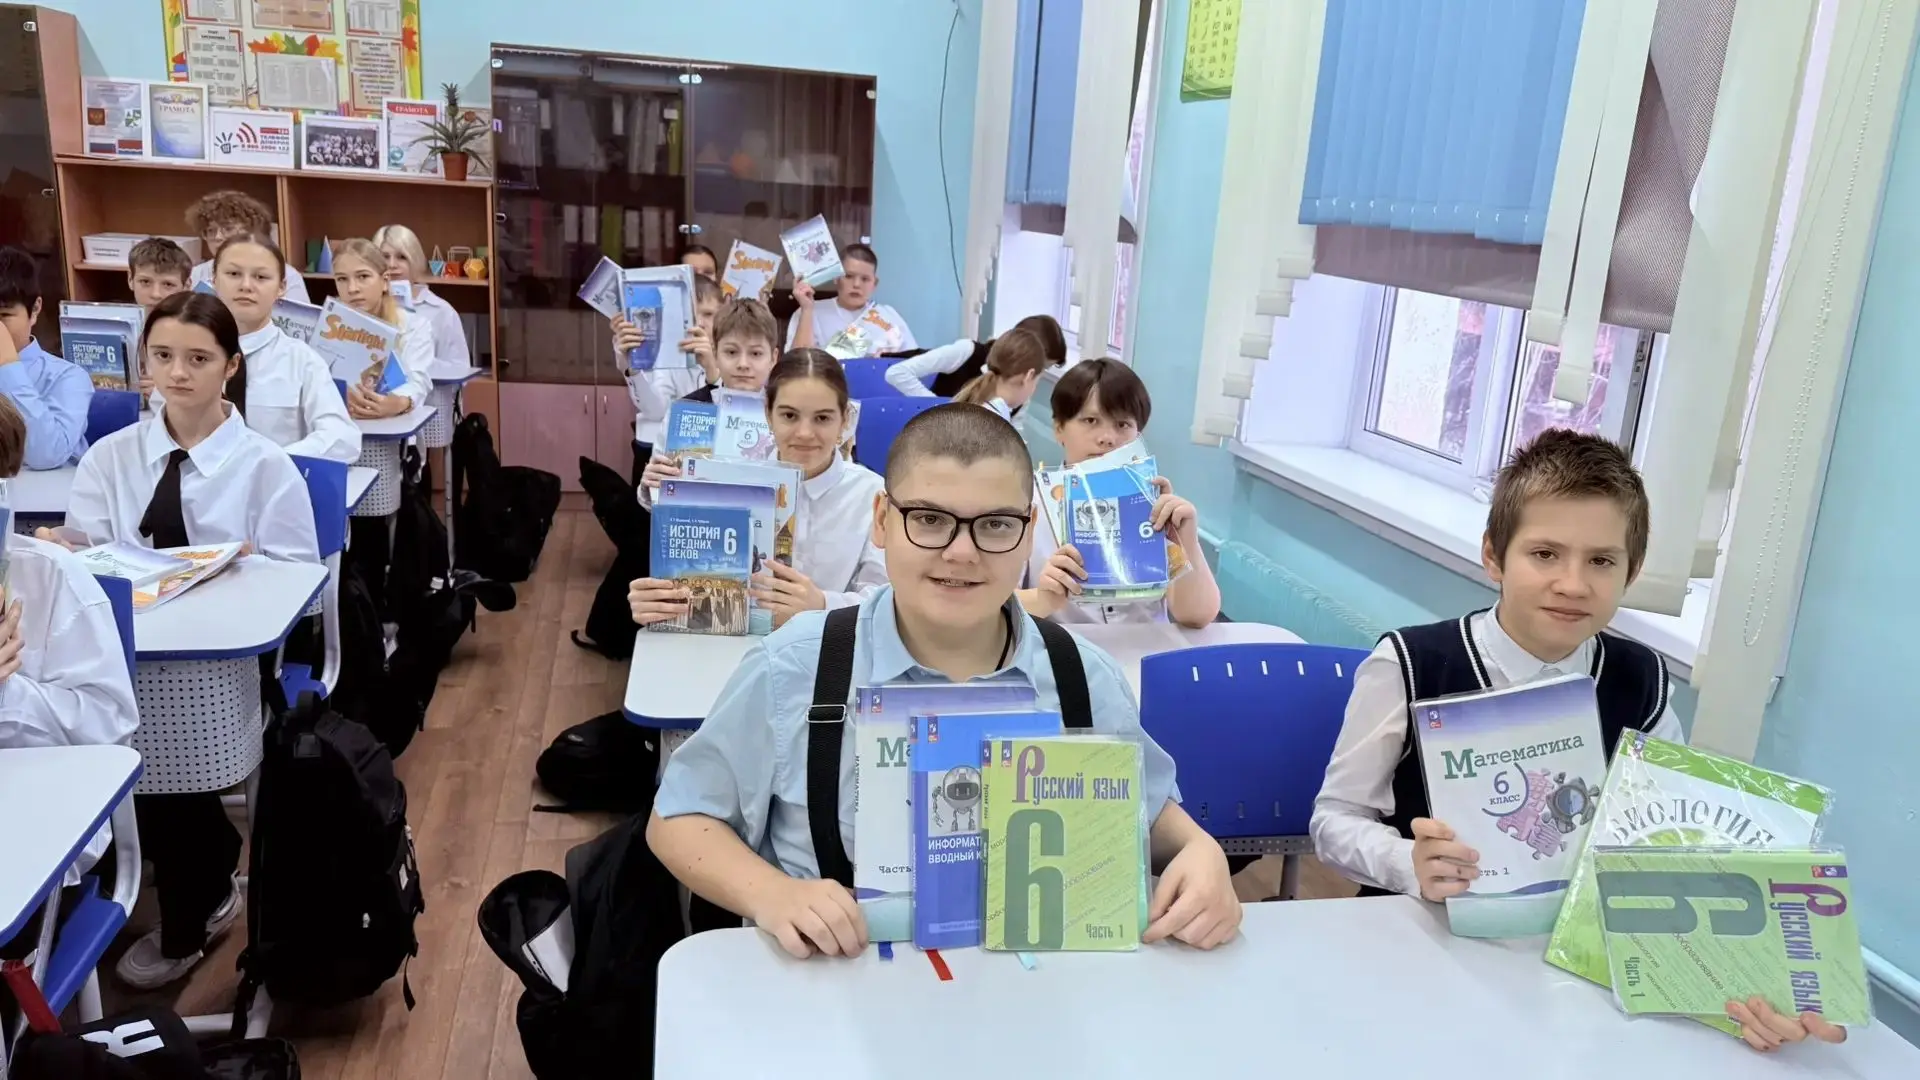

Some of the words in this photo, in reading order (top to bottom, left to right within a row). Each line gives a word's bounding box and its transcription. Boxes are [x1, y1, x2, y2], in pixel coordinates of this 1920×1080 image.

[395, 105, 429, 114] ГРАМОТА
[106, 345, 117, 364] 6
[743, 429, 753, 441] 6
[669, 524, 721, 541] ИСТОРИЯ
[1138, 520, 1154, 539] 6
[669, 537, 712, 551] СРЕДНИХ
[723, 527, 737, 555] 6
[668, 548, 700, 560] ВЕКОВ
[1440, 734, 1585, 781] Математика
[1011, 744, 1085, 806] Русский
[1092, 777, 1131, 800] язык
[1493, 770, 1511, 796] 6
[1488, 793, 1521, 806] КЛАСС
[1611, 798, 1776, 846] БИОЛОГИЯ
[927, 849, 974, 864] ВВОДНЫЙ
[879, 864, 912, 874] Часть
[1503, 867, 1510, 876] 1
[1003, 808, 1065, 950] 6
[1596, 870, 1767, 936] 6
[1767, 878, 1848, 961] Русский
[1085, 923, 1114, 939] Часть
[1118, 923, 1125, 939] 1
[1623, 956, 1641, 987] Часть
[1789, 969, 1824, 1014] язык
